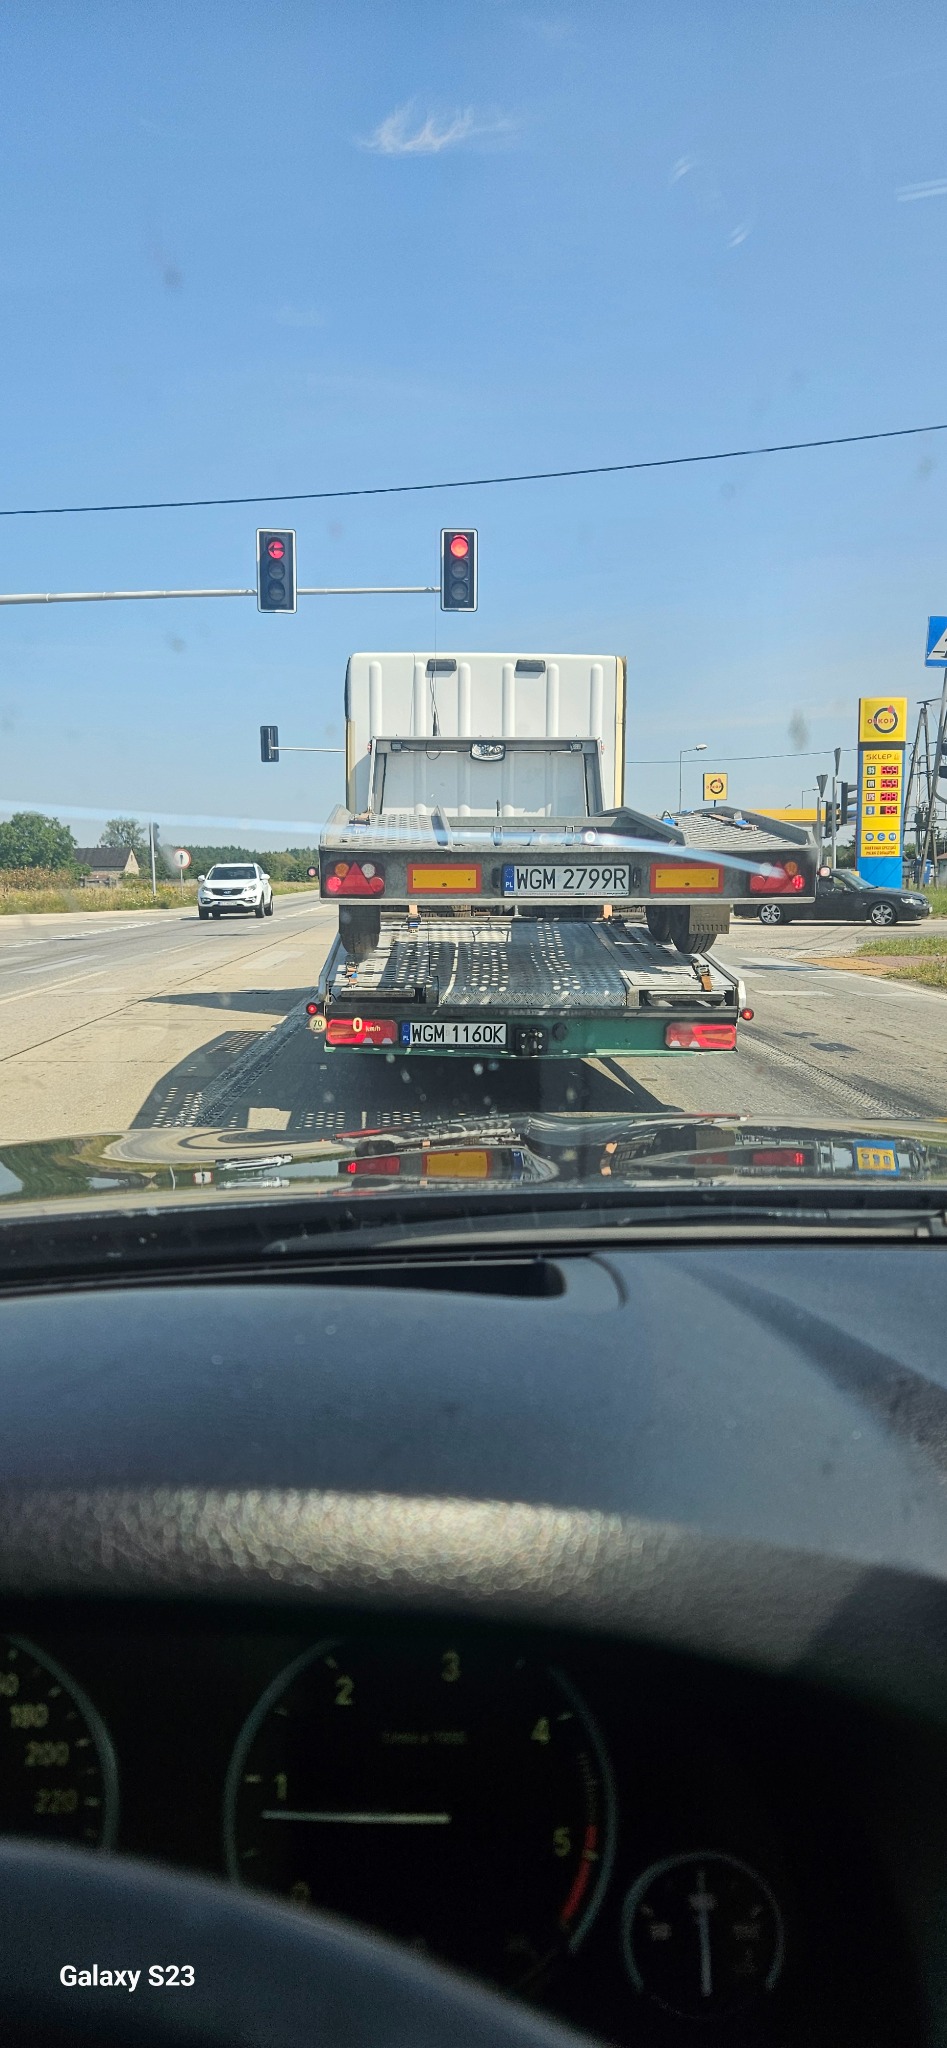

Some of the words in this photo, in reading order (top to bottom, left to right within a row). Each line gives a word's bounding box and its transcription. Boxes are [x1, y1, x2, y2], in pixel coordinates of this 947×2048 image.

[867, 766, 875, 774] 95
[516, 868, 555, 889] WGM
[563, 868, 626, 889] 2799R
[352, 1017, 363, 1032] 0
[412, 1024, 445, 1042] WGM
[452, 1025, 504, 1043] 1160K
[441, 1649, 461, 1682] 3
[335, 1674, 355, 1706] 2
[9, 1703, 49, 1728] 180
[531, 1716, 551, 1744] 4
[25, 1741, 70, 1766] 200
[275, 1772, 288, 1800] 1
[34, 1789, 78, 1814] 220
[553, 1826, 572, 1857] 5
